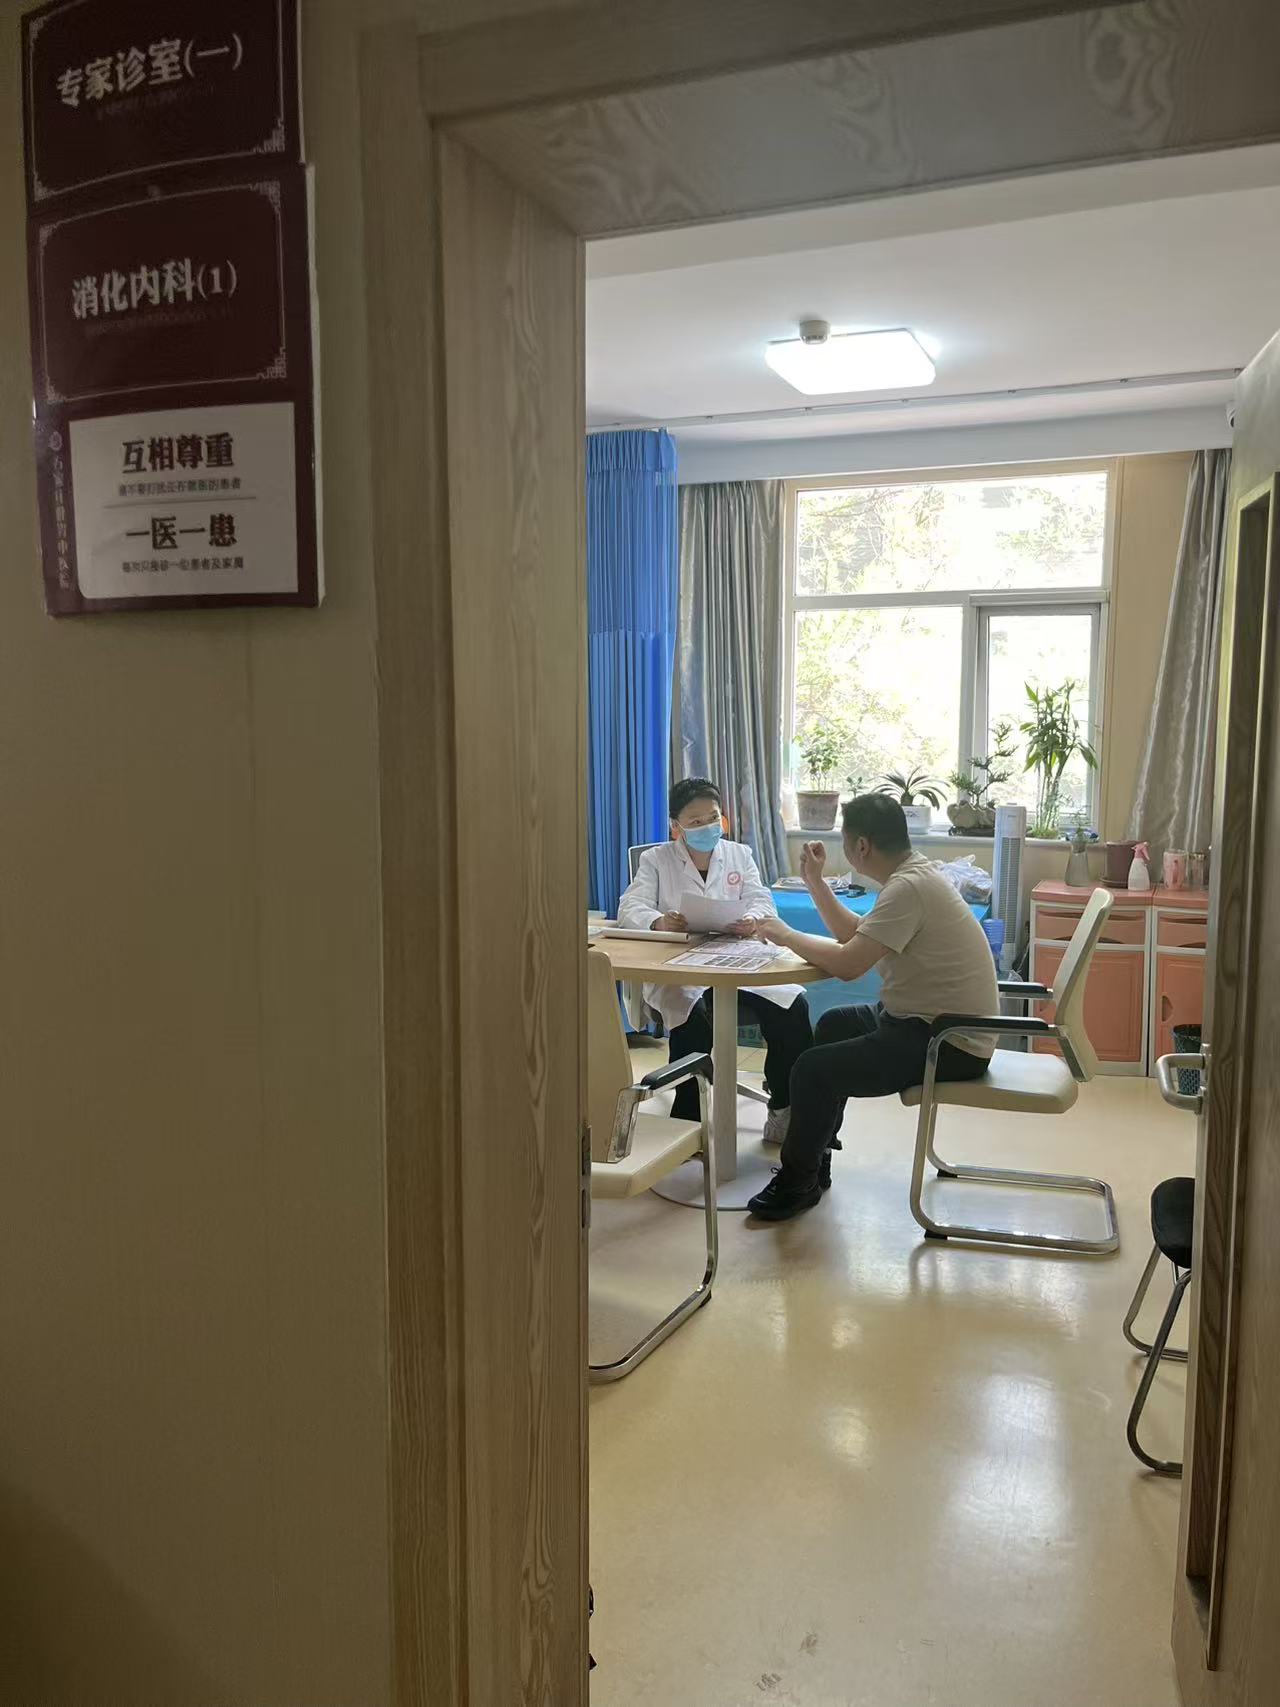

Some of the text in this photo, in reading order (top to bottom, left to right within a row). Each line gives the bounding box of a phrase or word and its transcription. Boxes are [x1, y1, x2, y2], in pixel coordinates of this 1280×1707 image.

[57, 33, 243, 107] 专家诊室(一)
[72, 258, 237, 319] 消化内科(1)
[122, 432, 234, 473] 互相尊重
[126, 513, 237, 550] 一医一患
